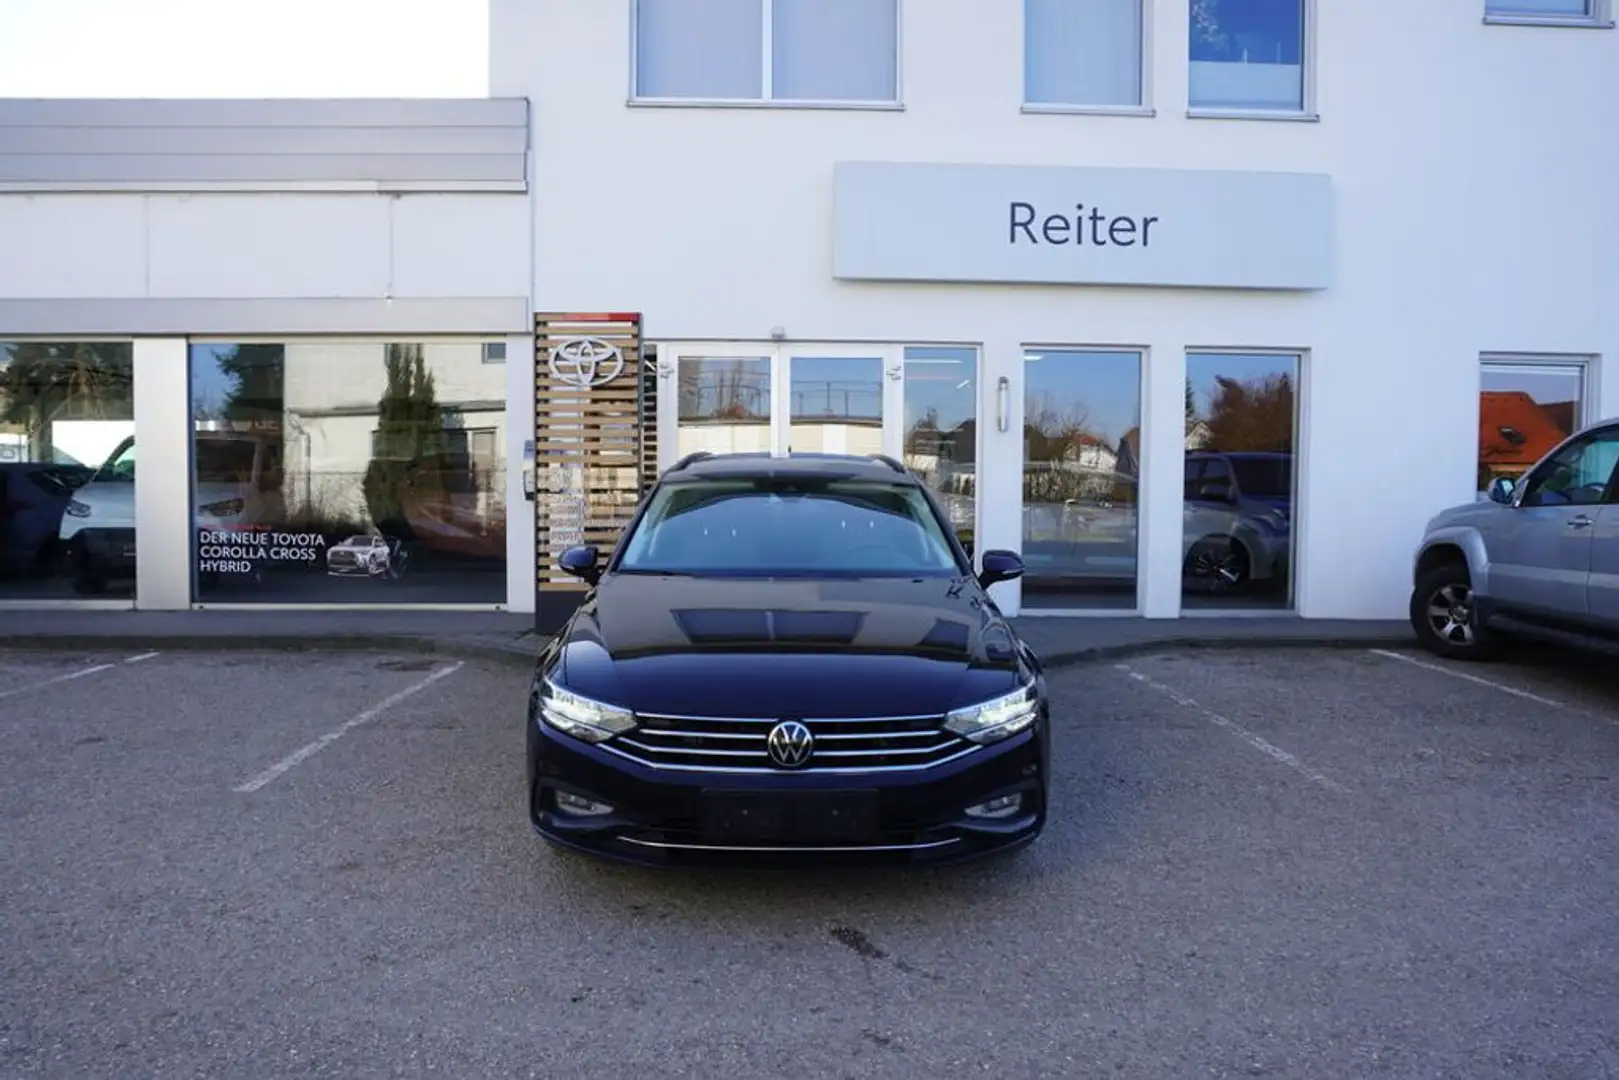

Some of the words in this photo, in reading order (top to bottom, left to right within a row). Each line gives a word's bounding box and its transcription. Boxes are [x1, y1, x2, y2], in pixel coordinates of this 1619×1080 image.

[1010, 202, 1159, 247] Reiter
[200, 531, 227, 544] DER
[231, 532, 268, 545] NEUE
[272, 533, 325, 546] TOYOTA
[200, 546, 266, 560] COROLLA
[269, 548, 316, 560] CROSS
[200, 561, 251, 573] HYBRID
[768, 721, 813, 767] VW
